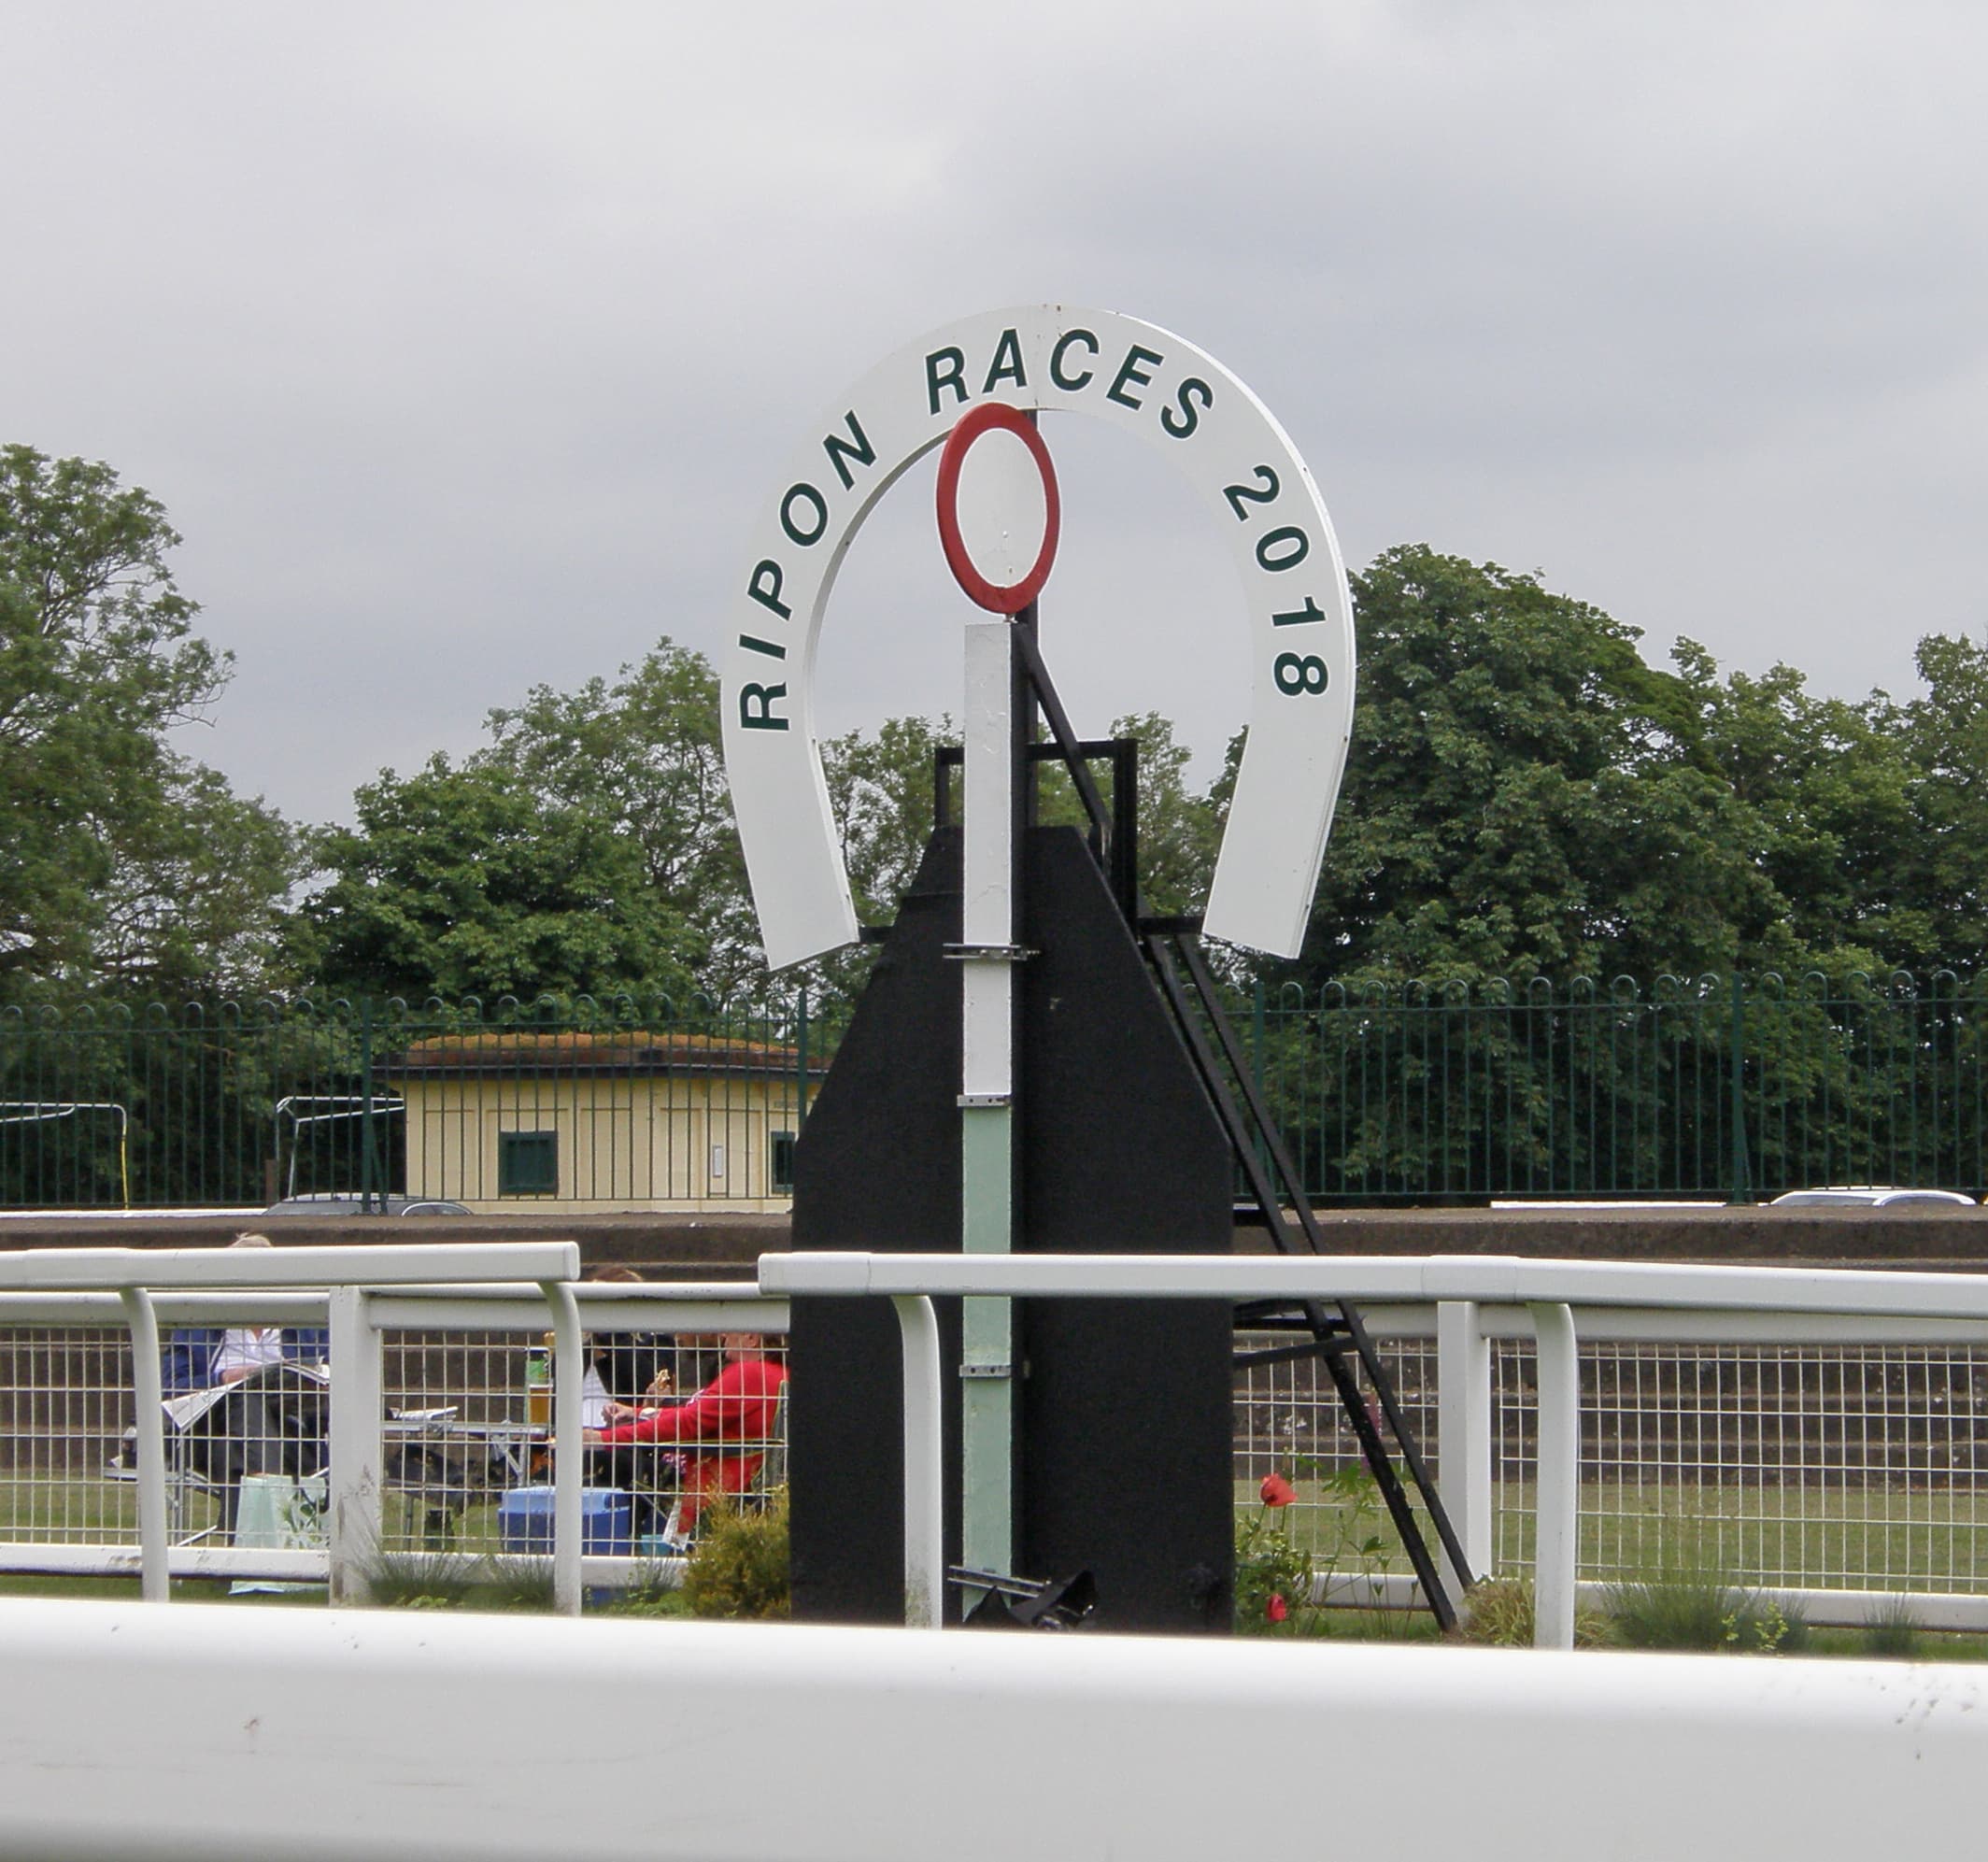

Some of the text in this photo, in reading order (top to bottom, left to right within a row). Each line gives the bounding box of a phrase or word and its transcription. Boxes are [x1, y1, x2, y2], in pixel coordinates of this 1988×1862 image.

[740, 329, 1328, 732] RIPON RACES 2018
